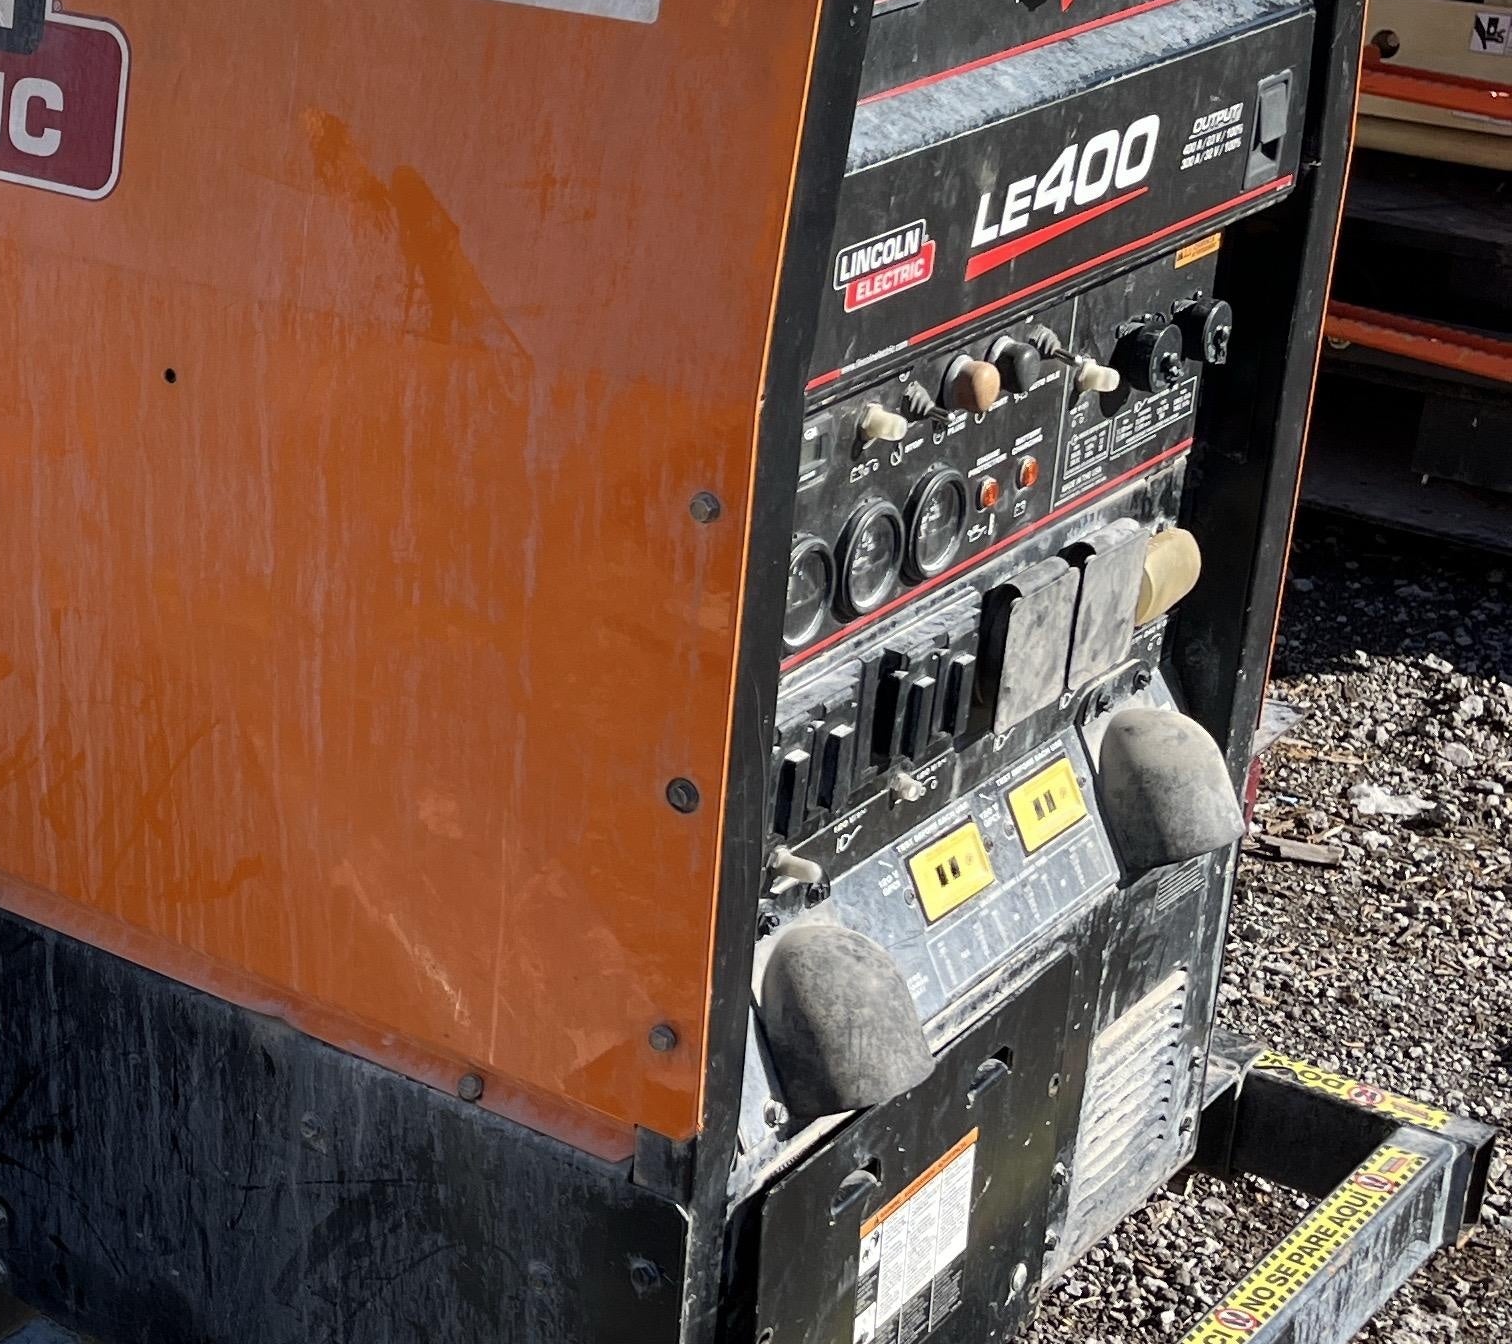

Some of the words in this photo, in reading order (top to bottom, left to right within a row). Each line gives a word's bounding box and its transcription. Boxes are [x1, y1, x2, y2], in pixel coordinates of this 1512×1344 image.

[1192, 102, 1244, 133] OUTPUT
[970, 113, 1161, 249] LE400
[839, 228, 921, 282] LINCOLN
[855, 258, 925, 302] ELECTRIC
[1239, 1285, 1276, 1312] NO
[1264, 1263, 1299, 1287] SE
[1285, 1224, 1339, 1266] PARE
